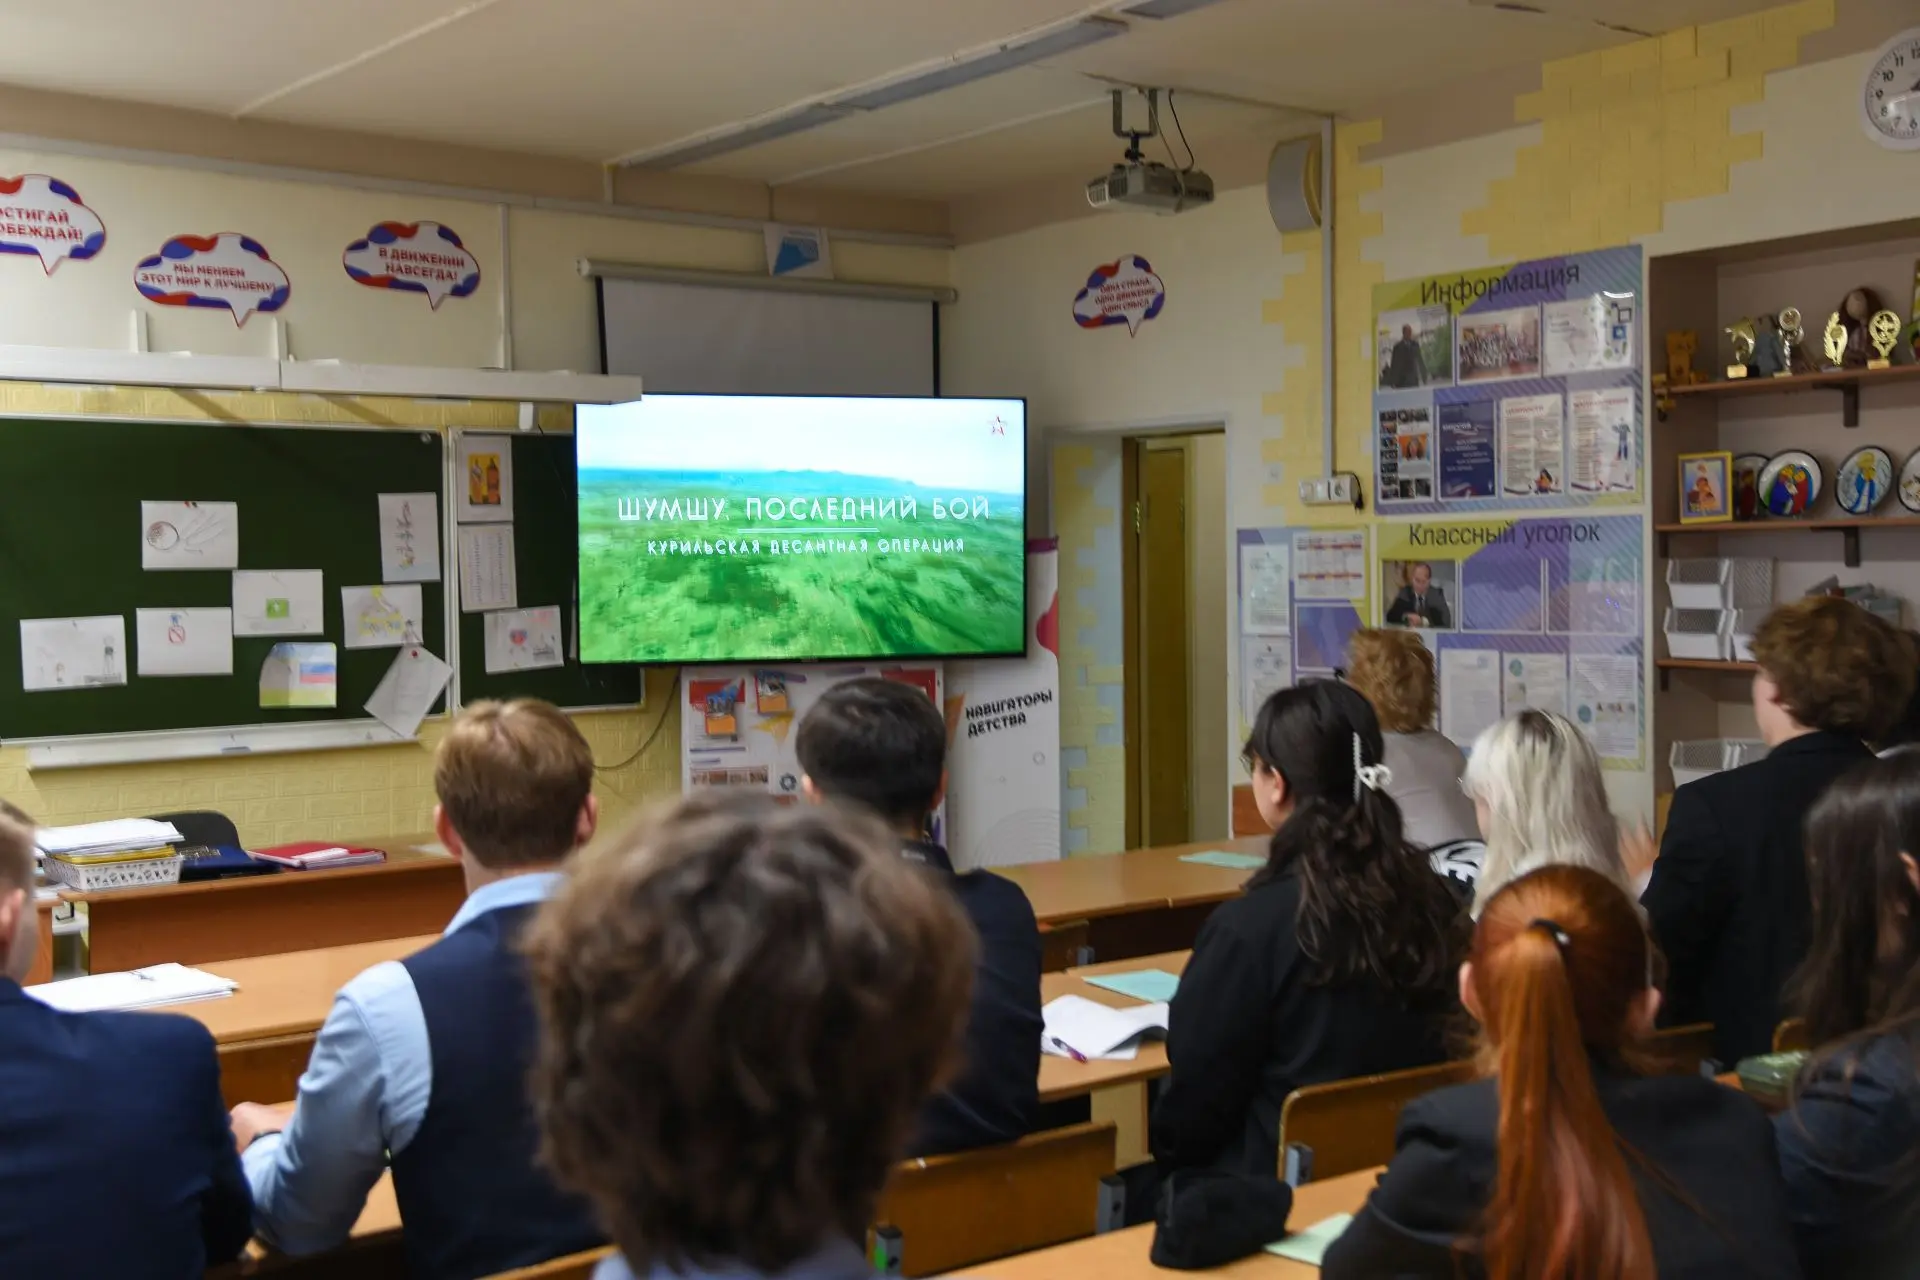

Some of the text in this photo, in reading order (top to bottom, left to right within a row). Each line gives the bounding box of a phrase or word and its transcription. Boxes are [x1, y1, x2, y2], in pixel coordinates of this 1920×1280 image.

[1893, 51, 1904, 67] 11
[1882, 69, 1894, 82] 10
[1876, 89, 1884, 100] 9
[1910, 118, 1918, 130] 6
[379, 247, 465, 267] В ДВИЖЕНИИ
[174, 263, 245, 277] МЫ МЕНЯЕМ
[385, 263, 458, 282] НАВСЕГДА!
[141, 272, 173, 285] ЭТОТ
[176, 276, 200, 288] МИР
[203, 278, 211, 288] К
[1421, 263, 1580, 305] Информация
[746, 495, 918, 522] ПОСЛЕДНИЙ
[932, 495, 990, 520] БОЙ
[1409, 520, 1601, 549] Классный уголок
[648, 537, 964, 556] КУРИЛЬСКАЯ ДЕСАНТНАЯ ОПЕРАЦИЯ
[965, 688, 1052, 720] НАВИГАТОРЫ
[967, 711, 1027, 739] ДЕТСТВА
